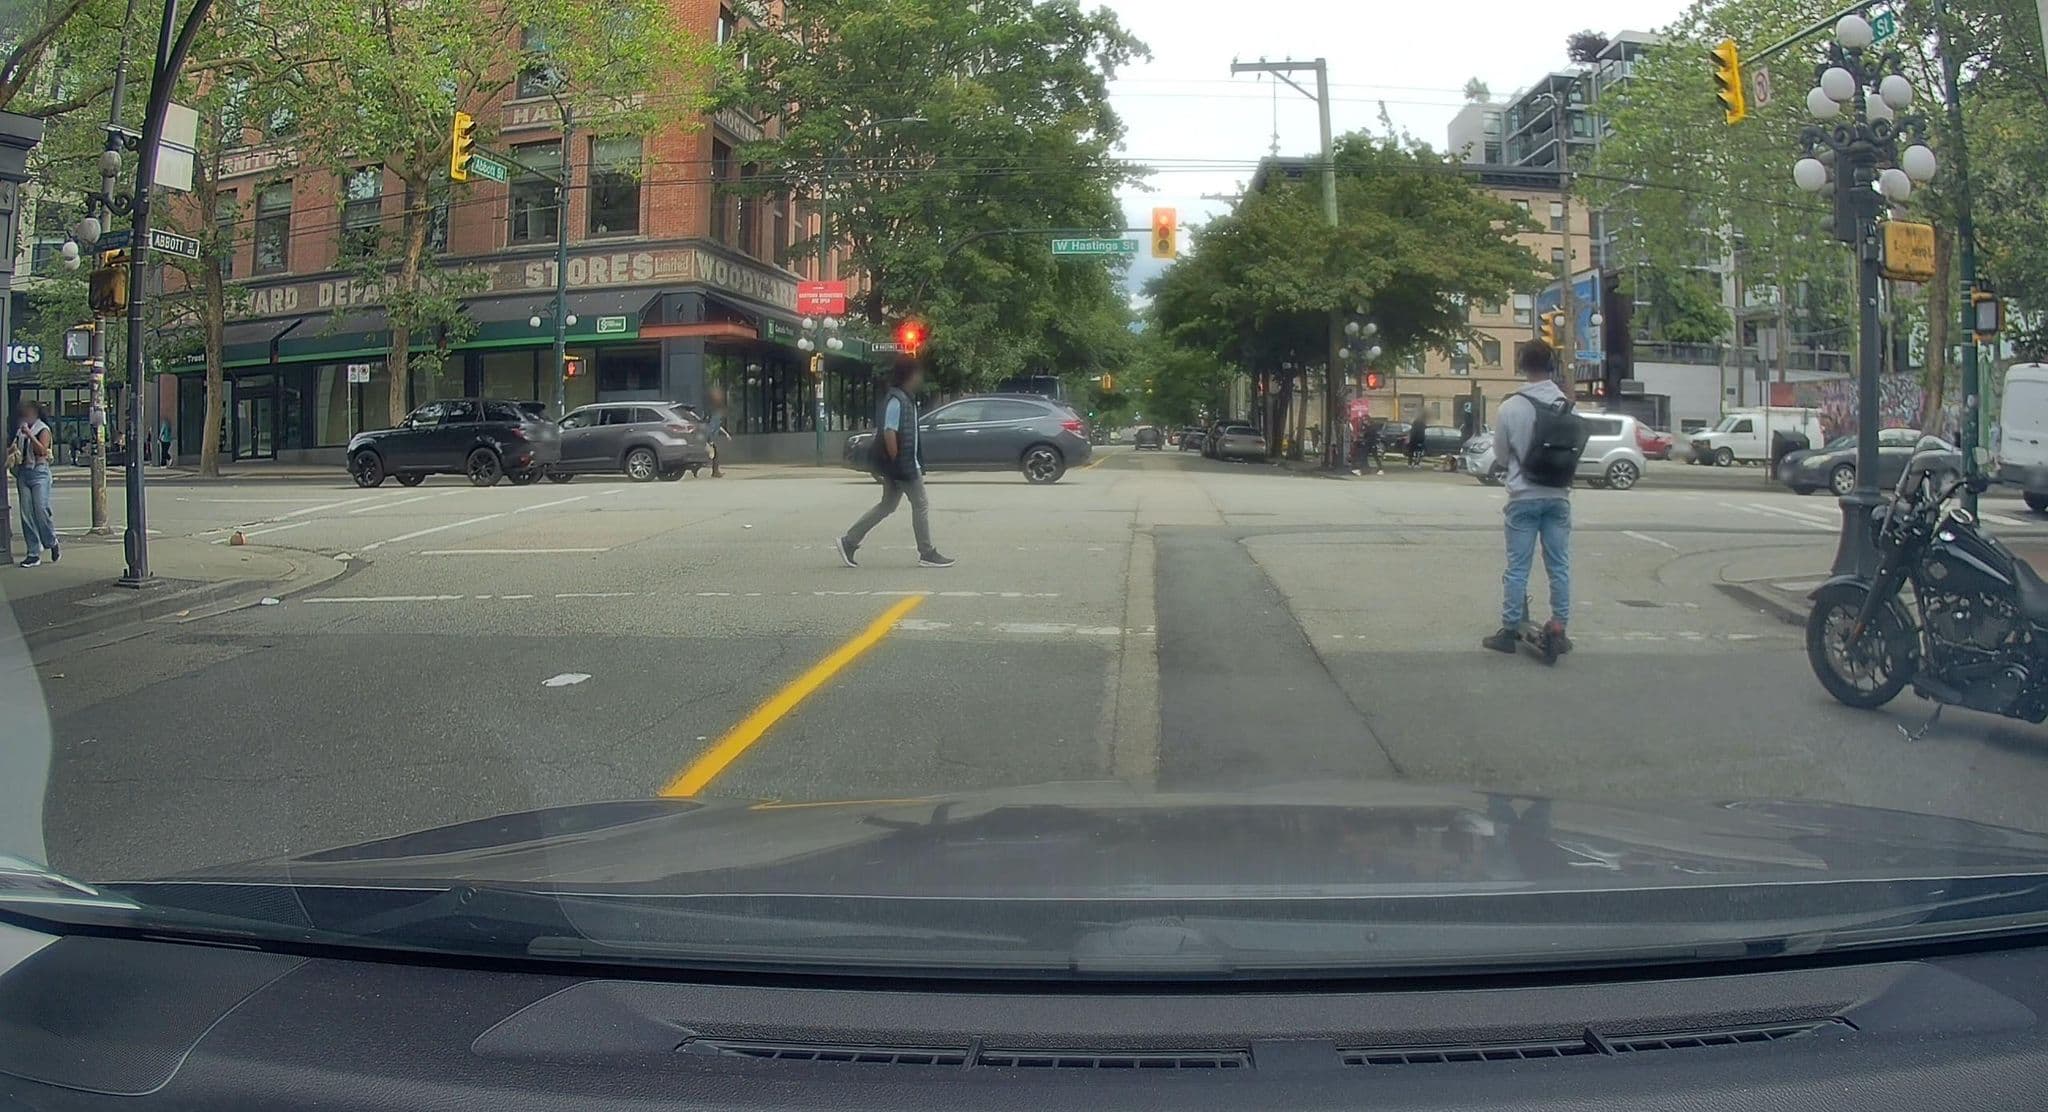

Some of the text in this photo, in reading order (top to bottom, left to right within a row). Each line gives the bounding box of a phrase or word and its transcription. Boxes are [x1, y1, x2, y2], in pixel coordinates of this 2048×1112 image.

[1876, 17, 1890, 37] St
[475, 158, 504, 180] Abbott St
[154, 234, 184, 252] ABBOTT
[1056, 240, 1135, 254] W Hastings St
[525, 252, 654, 288] STORES
[655, 255, 688, 275] Limited
